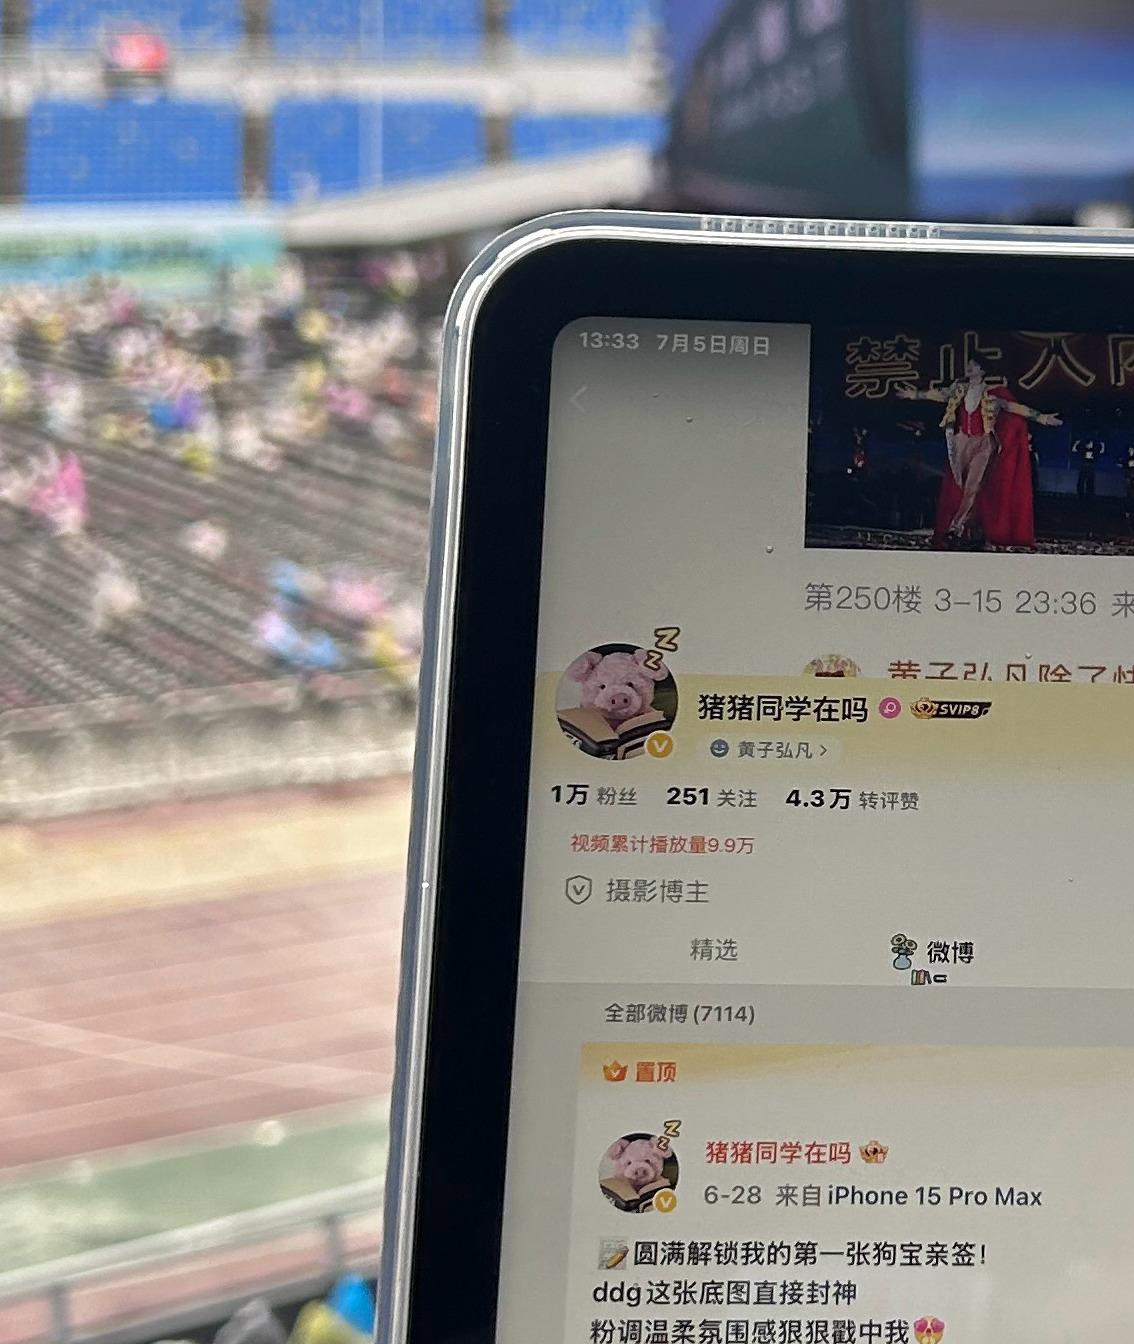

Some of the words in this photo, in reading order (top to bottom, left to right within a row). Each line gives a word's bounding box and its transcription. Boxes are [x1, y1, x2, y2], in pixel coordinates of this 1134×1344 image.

[578, 331, 640, 350] 13:33
[656, 333, 769, 356] 7月5日周日
[804, 582, 922, 614] 第250楼
[1015, 590, 1097, 616] 23:36
[697, 693, 869, 723] 猪猪同学在吗
[936, 700, 983, 720] SVIP8
[738, 741, 813, 759] 黄子弘凡
[551, 784, 590, 806] 1万
[597, 786, 637, 806] 粉丝
[666, 787, 709, 806] 251
[717, 788, 758, 808] 关注
[785, 788, 852, 810] 4.3万
[859, 791, 919, 811] 转评赞
[570, 833, 755, 855] 视频累计播放量9.9万
[605, 878, 709, 904] 摄影博主
[689, 937, 738, 962] 精选
[927, 940, 974, 965] 微博
[636, 1061, 677, 1083] 置顶
[705, 1140, 852, 1165] 猪猪同学在吗
[704, 1185, 762, 1205] 6-28
[775, 1183, 821, 1207] 来自
[828, 1185, 909, 1206] iPhone
[915, 1186, 941, 1206] 15
[949, 1186, 988, 1206] Pro
[995, 1186, 1042, 1206] Max
